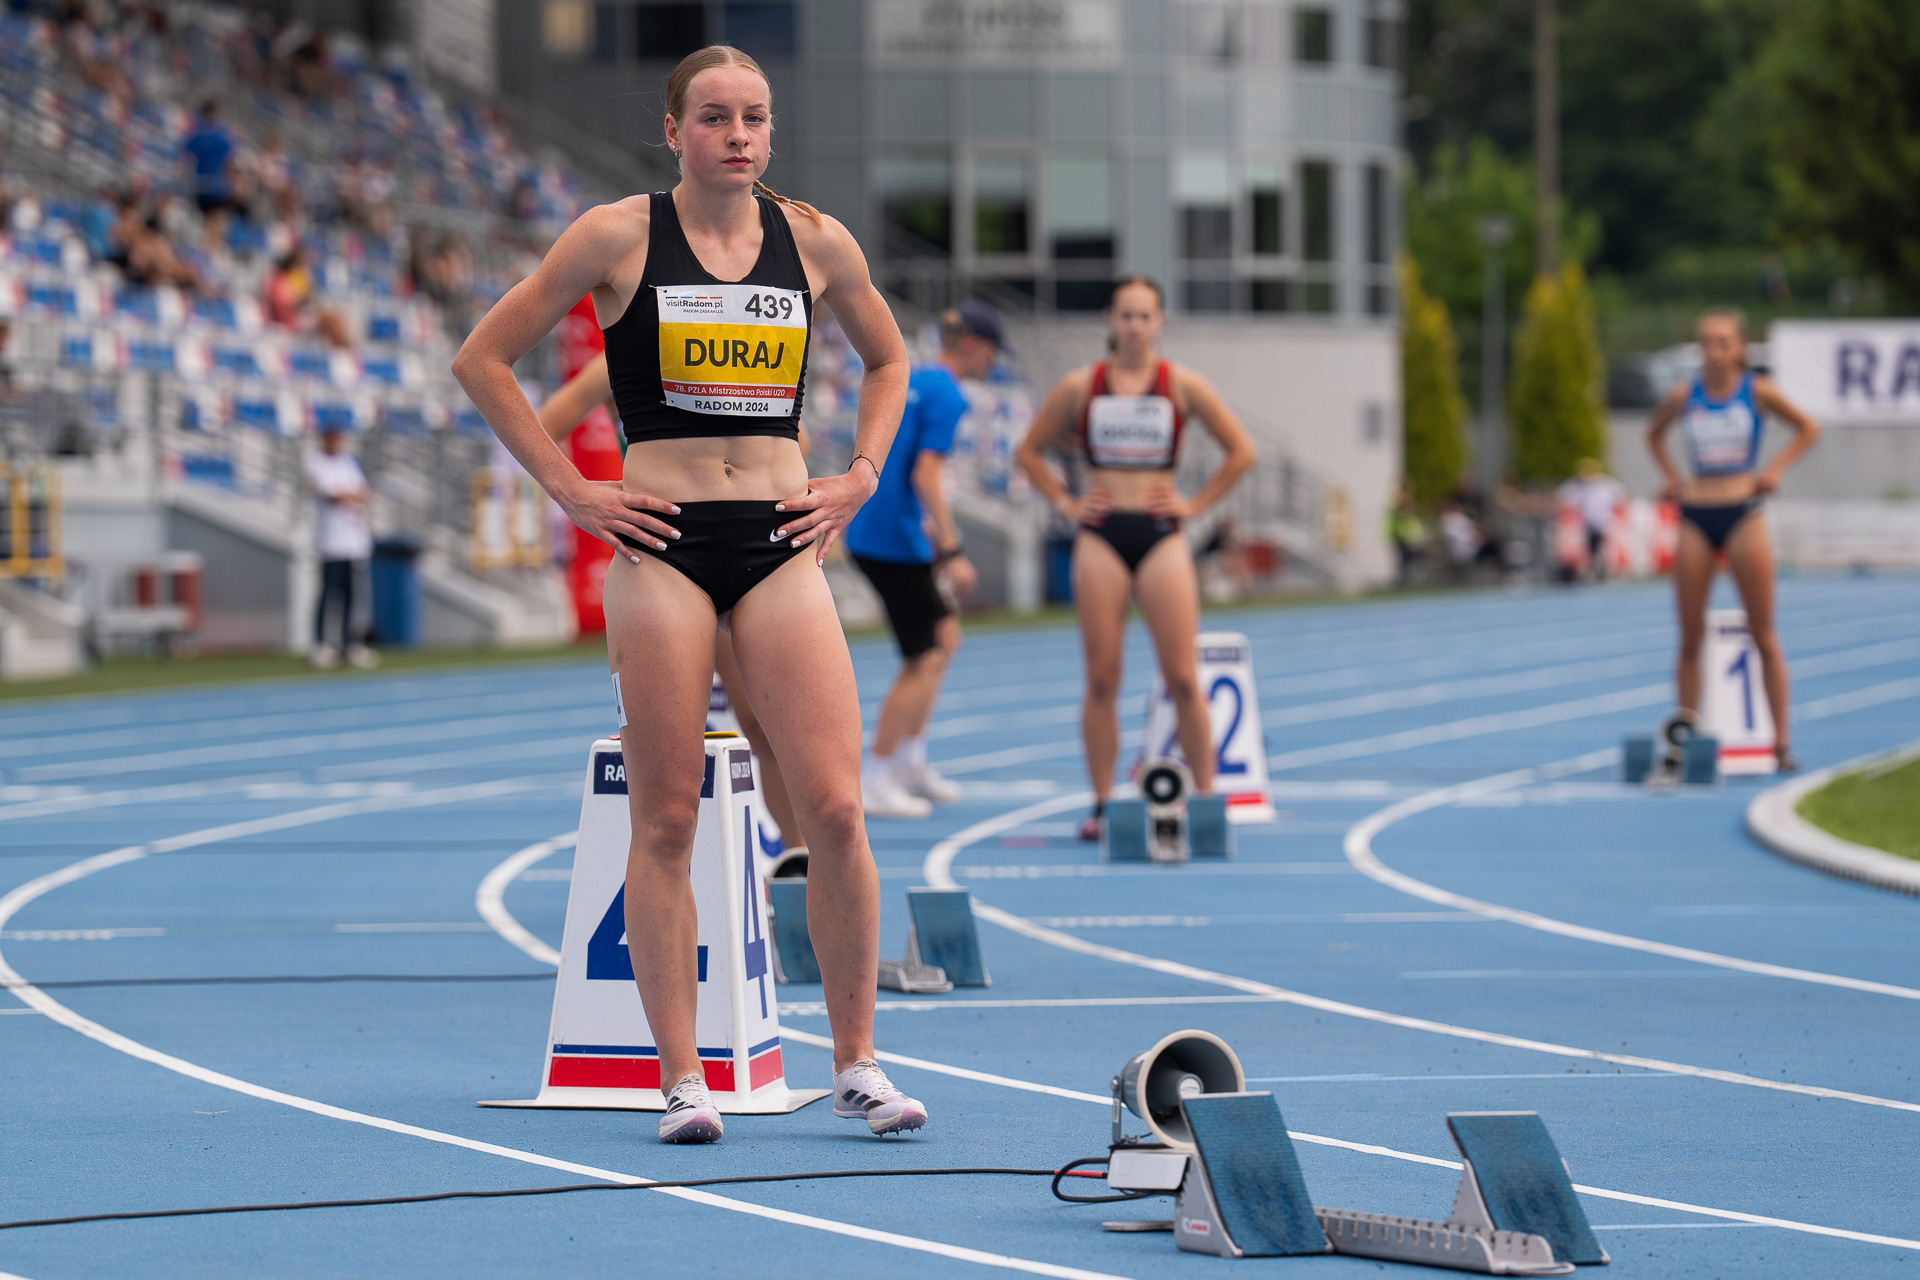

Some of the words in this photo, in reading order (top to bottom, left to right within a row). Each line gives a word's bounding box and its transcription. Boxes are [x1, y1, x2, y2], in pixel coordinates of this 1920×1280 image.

[666, 300, 724, 309] visitRadom.pl
[744, 293, 793, 320] 439
[684, 338, 785, 370] DURAJ
[674, 384, 687, 393] 78.
[687, 386, 707, 394] PZLA
[708, 387, 755, 396] Mistrzostwa
[756, 388, 773, 396] Polski
[773, 388, 786, 397] U20
[694, 399, 743, 412] RADOM
[745, 402, 769, 413] 2024
[1727, 649, 1754, 732] 1
[1209, 676, 1248, 774] 2
[604, 764, 629, 782] RA
[744, 804, 768, 1020] 4
